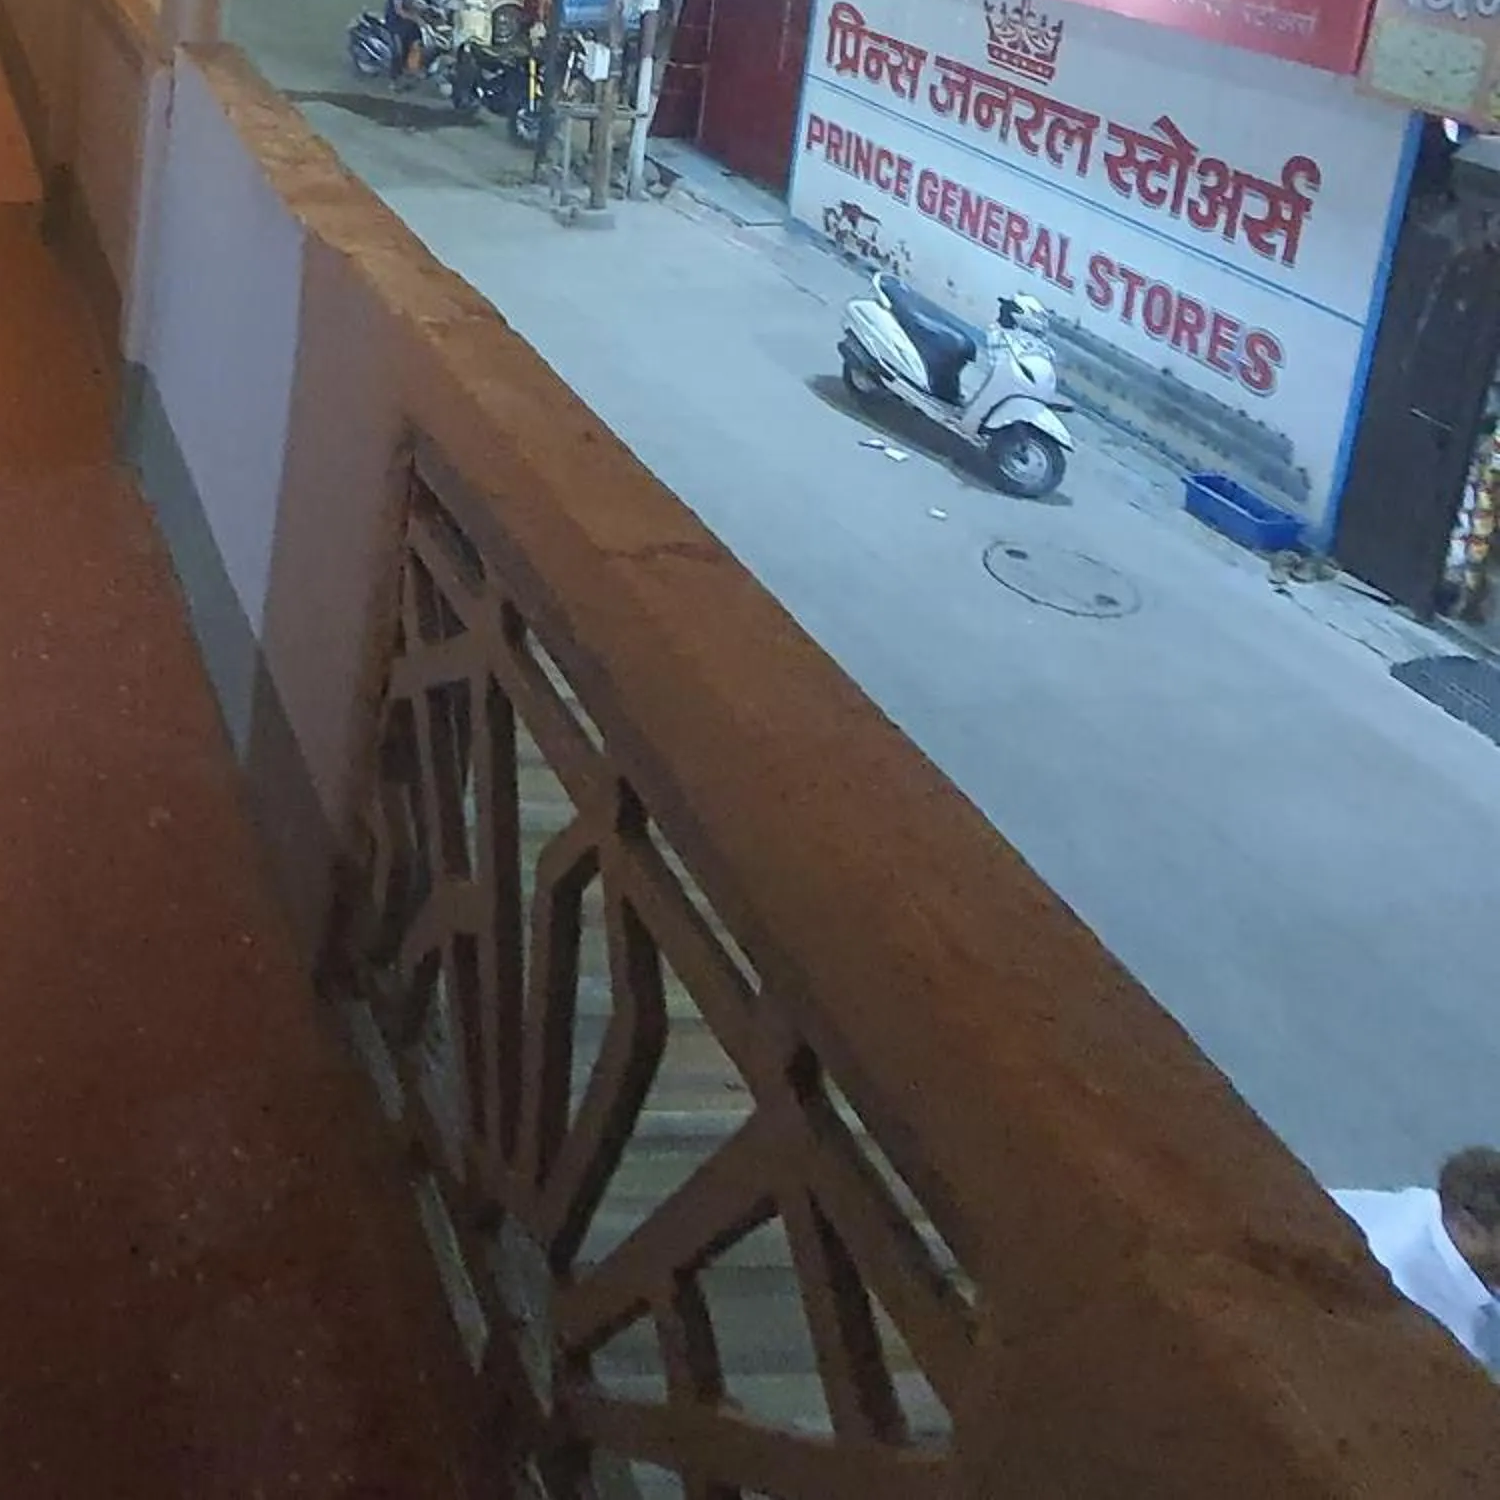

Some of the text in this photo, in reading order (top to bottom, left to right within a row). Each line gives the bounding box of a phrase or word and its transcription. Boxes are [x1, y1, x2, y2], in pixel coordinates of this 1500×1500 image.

[804, 112, 1288, 398] PRINCE GENERAL STORES
[827, 1, 1322, 268] प्रिन्स जनरल स्टोअर्स
